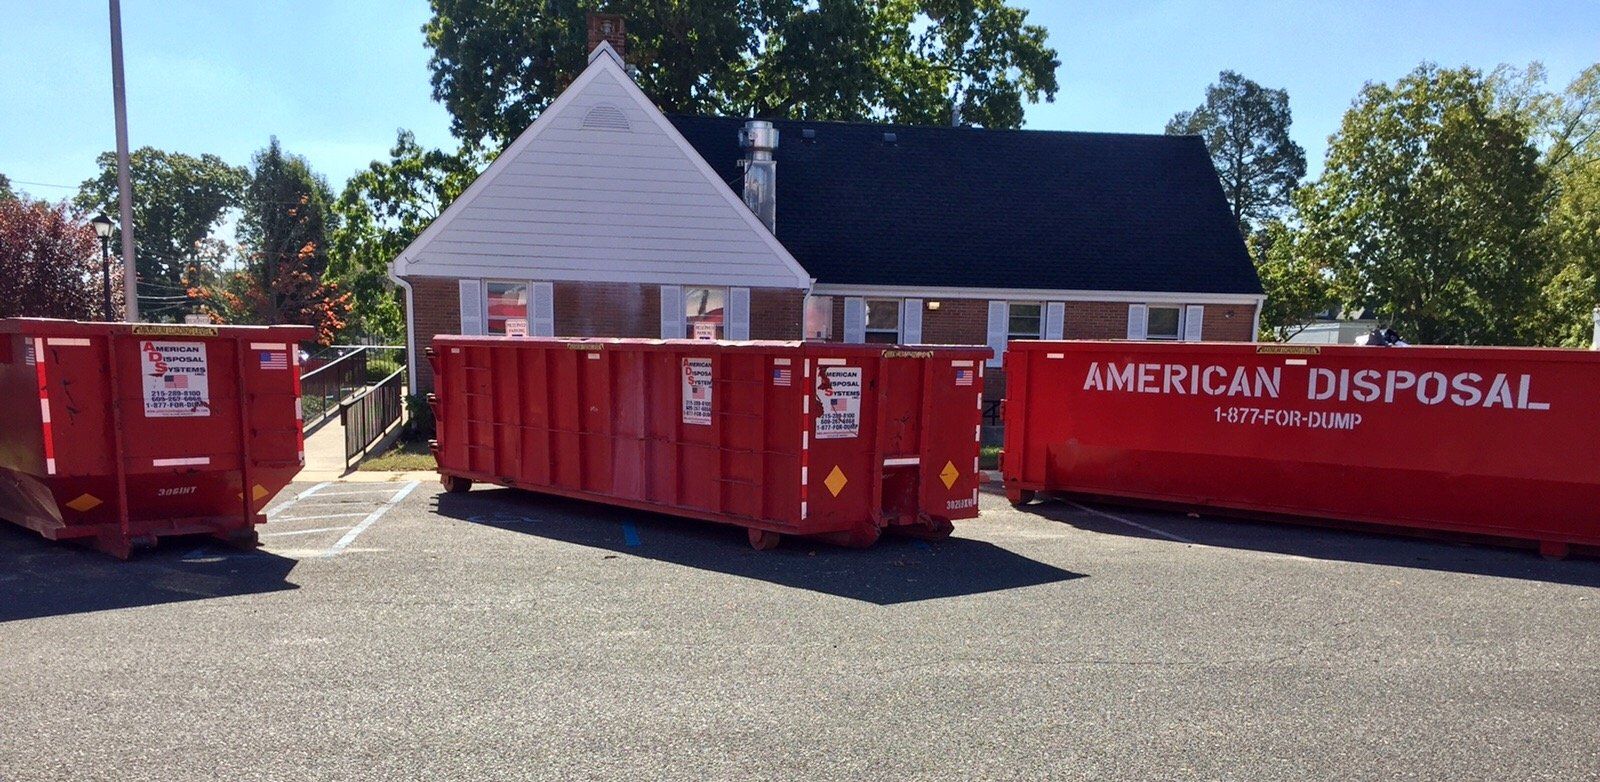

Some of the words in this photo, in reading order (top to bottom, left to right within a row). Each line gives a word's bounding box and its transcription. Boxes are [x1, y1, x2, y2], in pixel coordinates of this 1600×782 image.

[143, 342, 199, 352] AMERICAN
[149, 352, 204, 362] DISPOSAL
[155, 362, 206, 373] SYSTEMS
[684, 359, 711, 367] AMERICAN
[1083, 362, 1282, 399] AMERICAN
[1307, 368, 1550, 410] DISPOSAL
[825, 388, 860, 397] SYSTEMS
[1214, 406, 1363, 430] 1-877-FOR-DUMP
